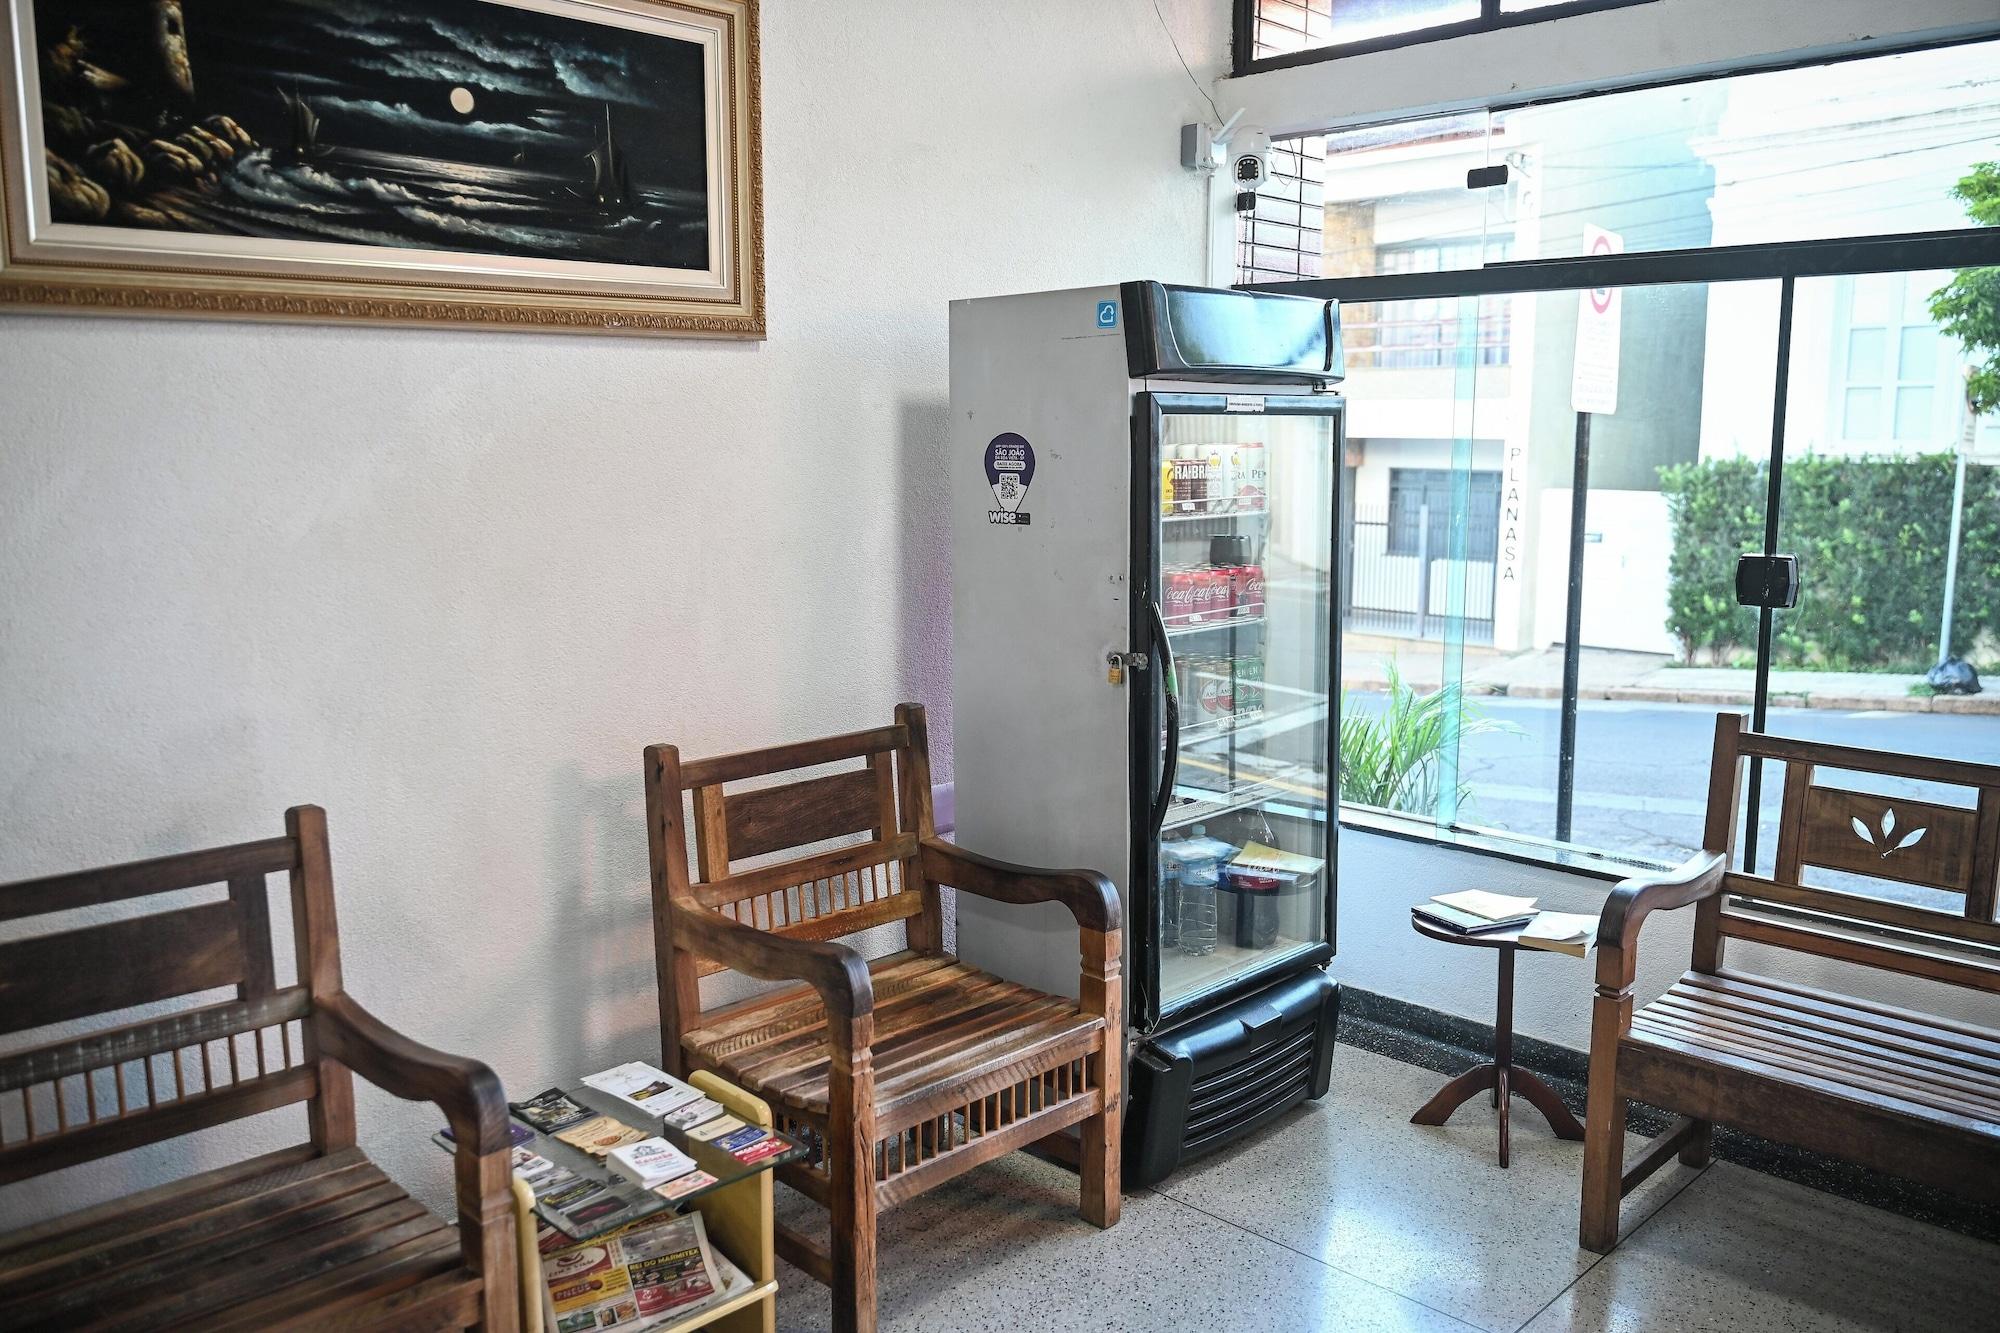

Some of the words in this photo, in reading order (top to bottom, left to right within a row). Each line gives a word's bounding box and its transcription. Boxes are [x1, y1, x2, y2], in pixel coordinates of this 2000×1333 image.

[994, 447, 1007, 456] SÃO
[1008, 447, 1026, 457] JOÃO
[989, 507, 1016, 524] wise
[1503, 447, 1521, 581] PLANASA
[629, 1261, 644, 1271] REI
[644, 1258, 657, 1267] DO
[657, 1248, 700, 1265] MARMITEX
